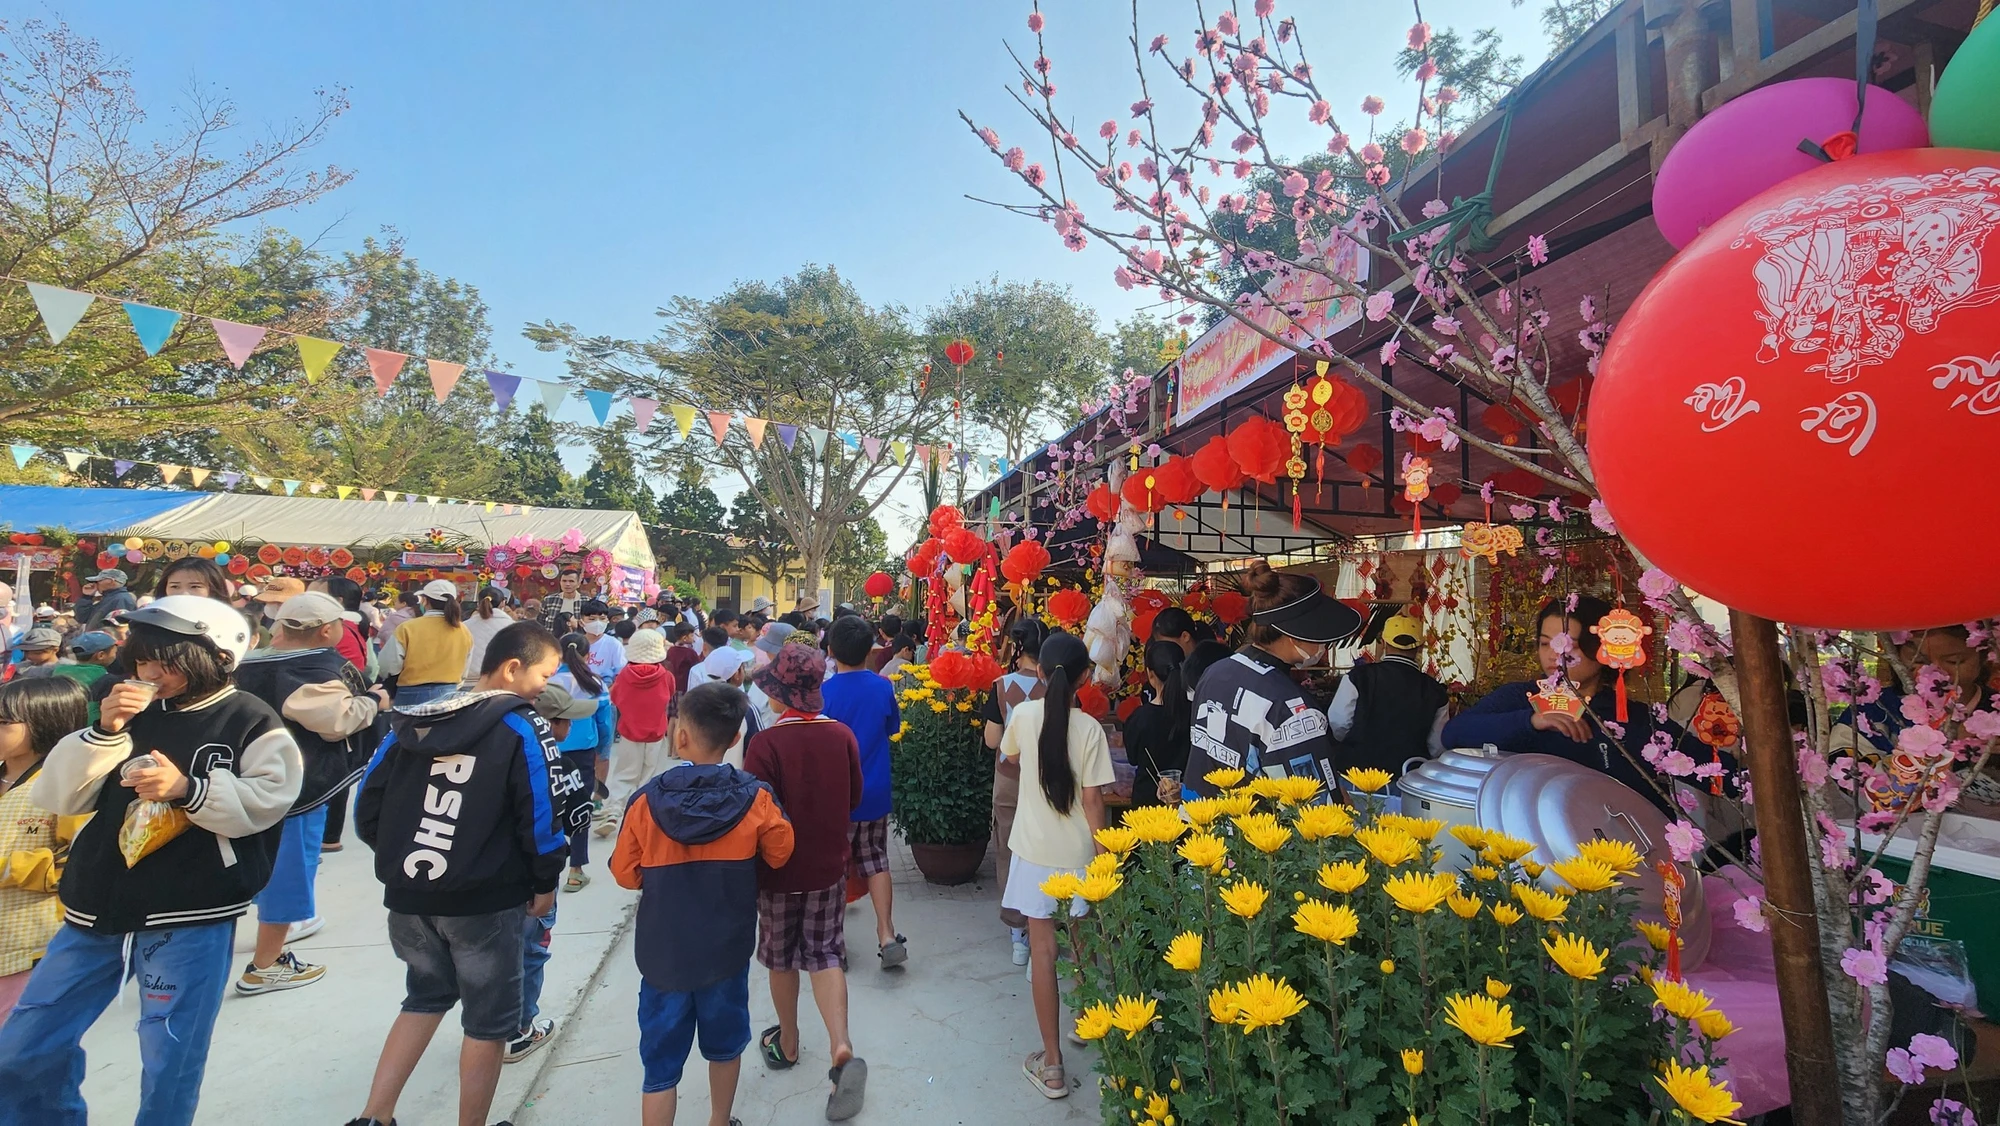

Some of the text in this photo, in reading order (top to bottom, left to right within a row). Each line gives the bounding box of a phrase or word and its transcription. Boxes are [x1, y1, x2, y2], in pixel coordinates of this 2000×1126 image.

[1684, 376, 1760, 432] Thọ
[1798, 391, 1877, 457] Lộc
[1548, 695, 1568, 710] 福
[403, 753, 477, 881] RSHC
